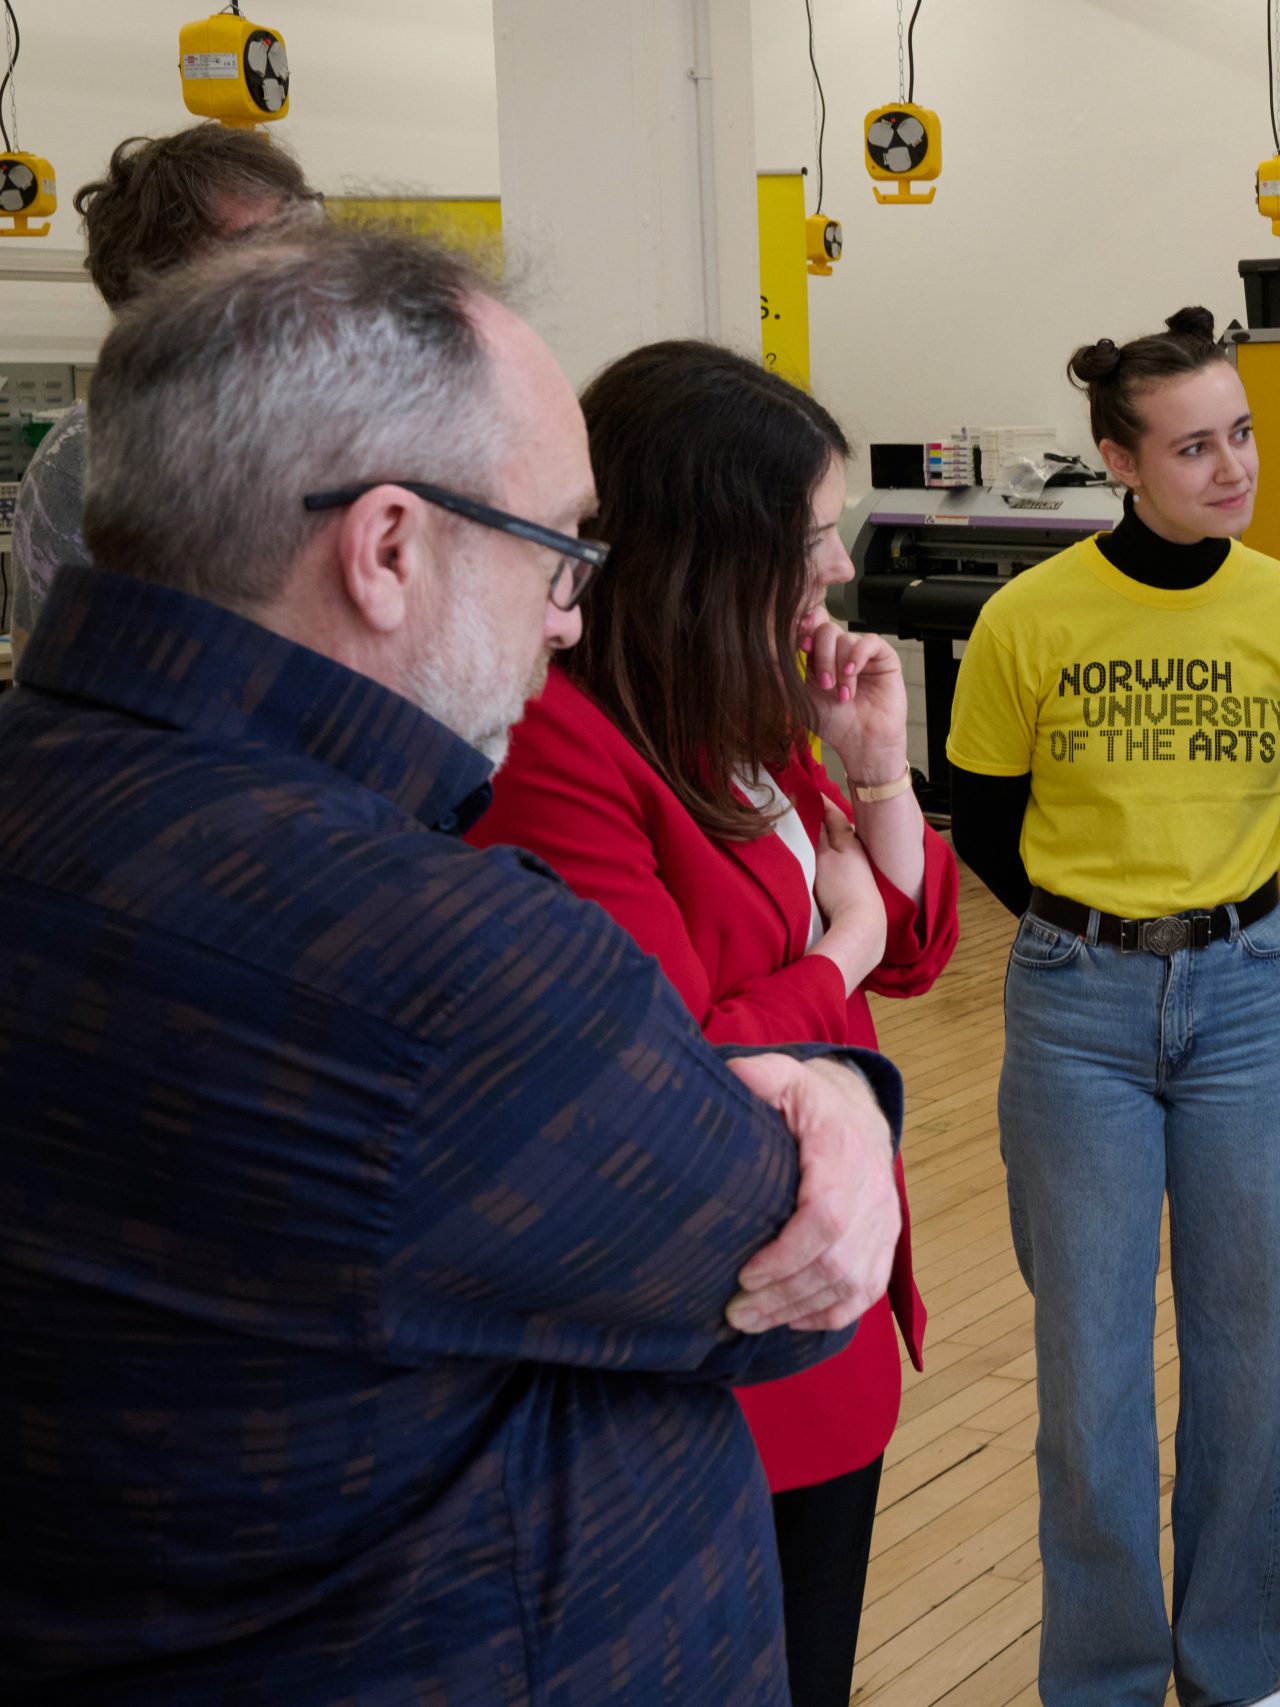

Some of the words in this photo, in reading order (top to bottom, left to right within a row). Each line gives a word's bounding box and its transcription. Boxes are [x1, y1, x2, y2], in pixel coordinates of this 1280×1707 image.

[1059, 658, 1232, 697] NORWICH
[1050, 729, 1089, 763] OF
[1099, 728, 1175, 762] THE
[1189, 728, 1276, 764] ARTS
